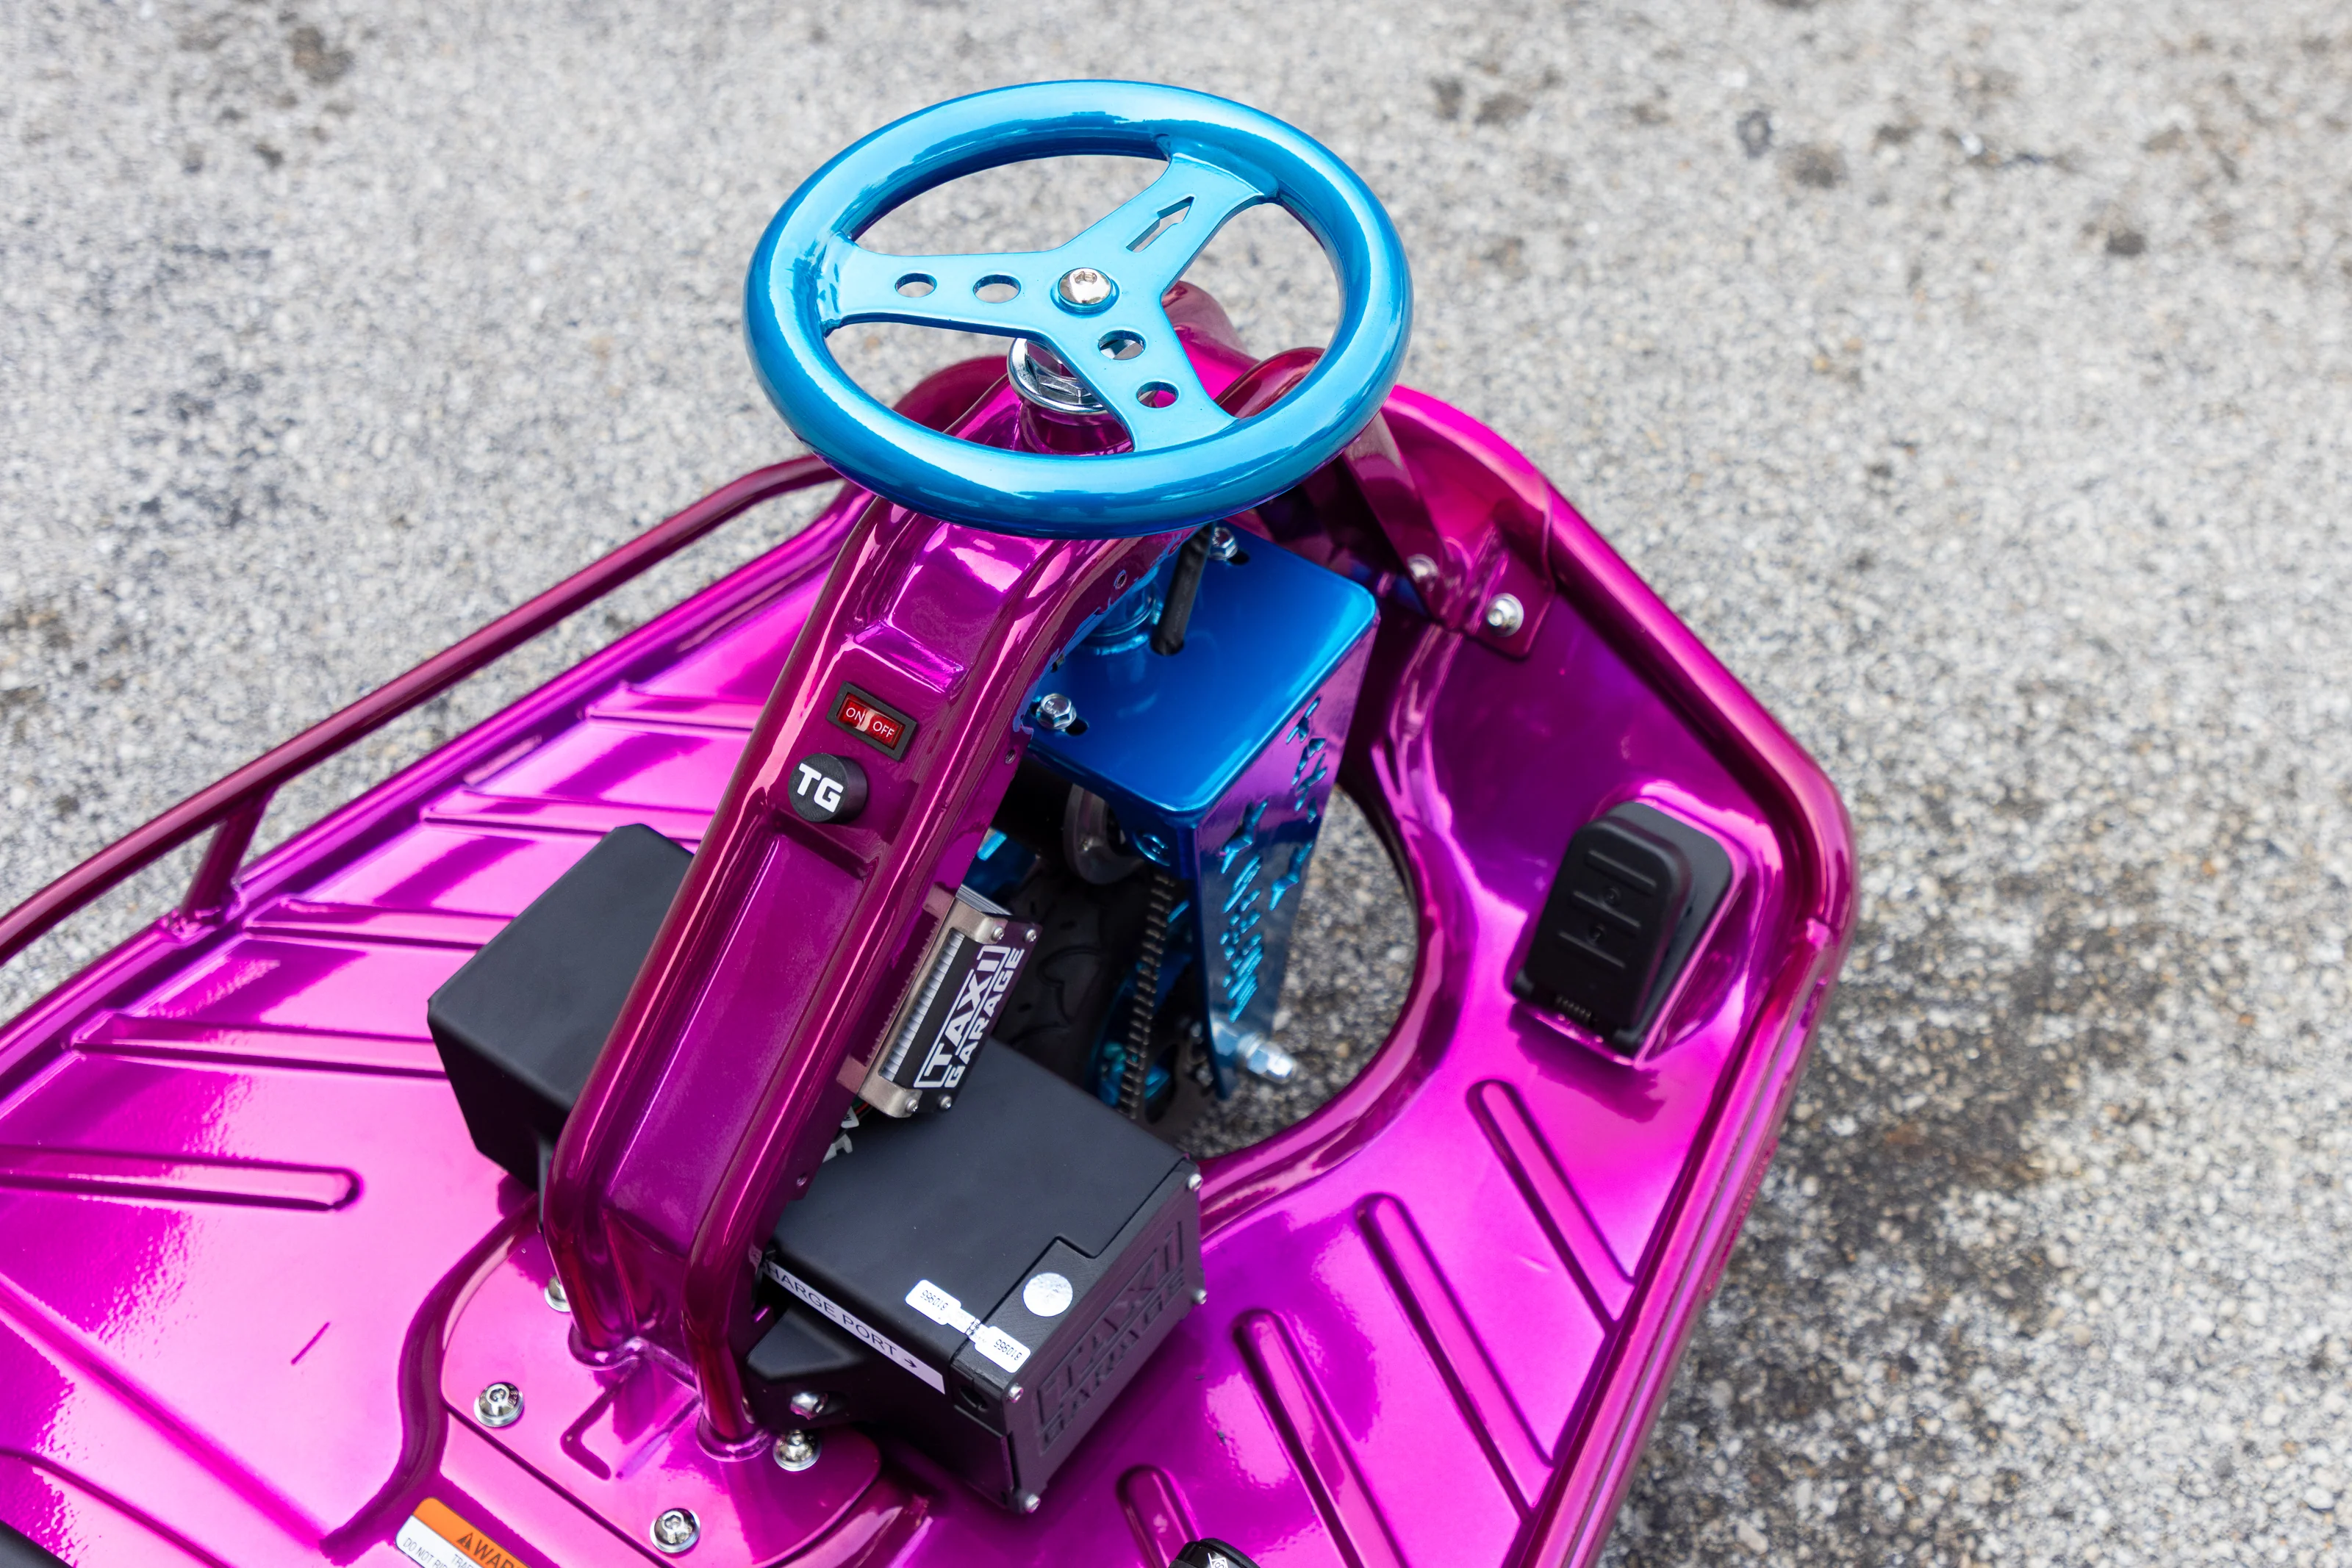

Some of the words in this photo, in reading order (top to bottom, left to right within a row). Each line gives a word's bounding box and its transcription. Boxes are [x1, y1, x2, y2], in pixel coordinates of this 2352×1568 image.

[845, 707, 866, 723] ON
[872, 721, 895, 738] OFF
[797, 763, 844, 813] TG
[922, 957, 1002, 1078] TAXI
[944, 947, 1025, 1088] GARAGE
[761, 1261, 837, 1318] HARGE
[842, 1313, 897, 1356] PORT
[1042, 1227, 1177, 1405] TAXI
[1040, 1273, 1185, 1456] GARAGE
[403, 1537, 417, 1552] DO
[416, 1547, 434, 1564] NOT
[451, 1554, 474, 1568] TRA
